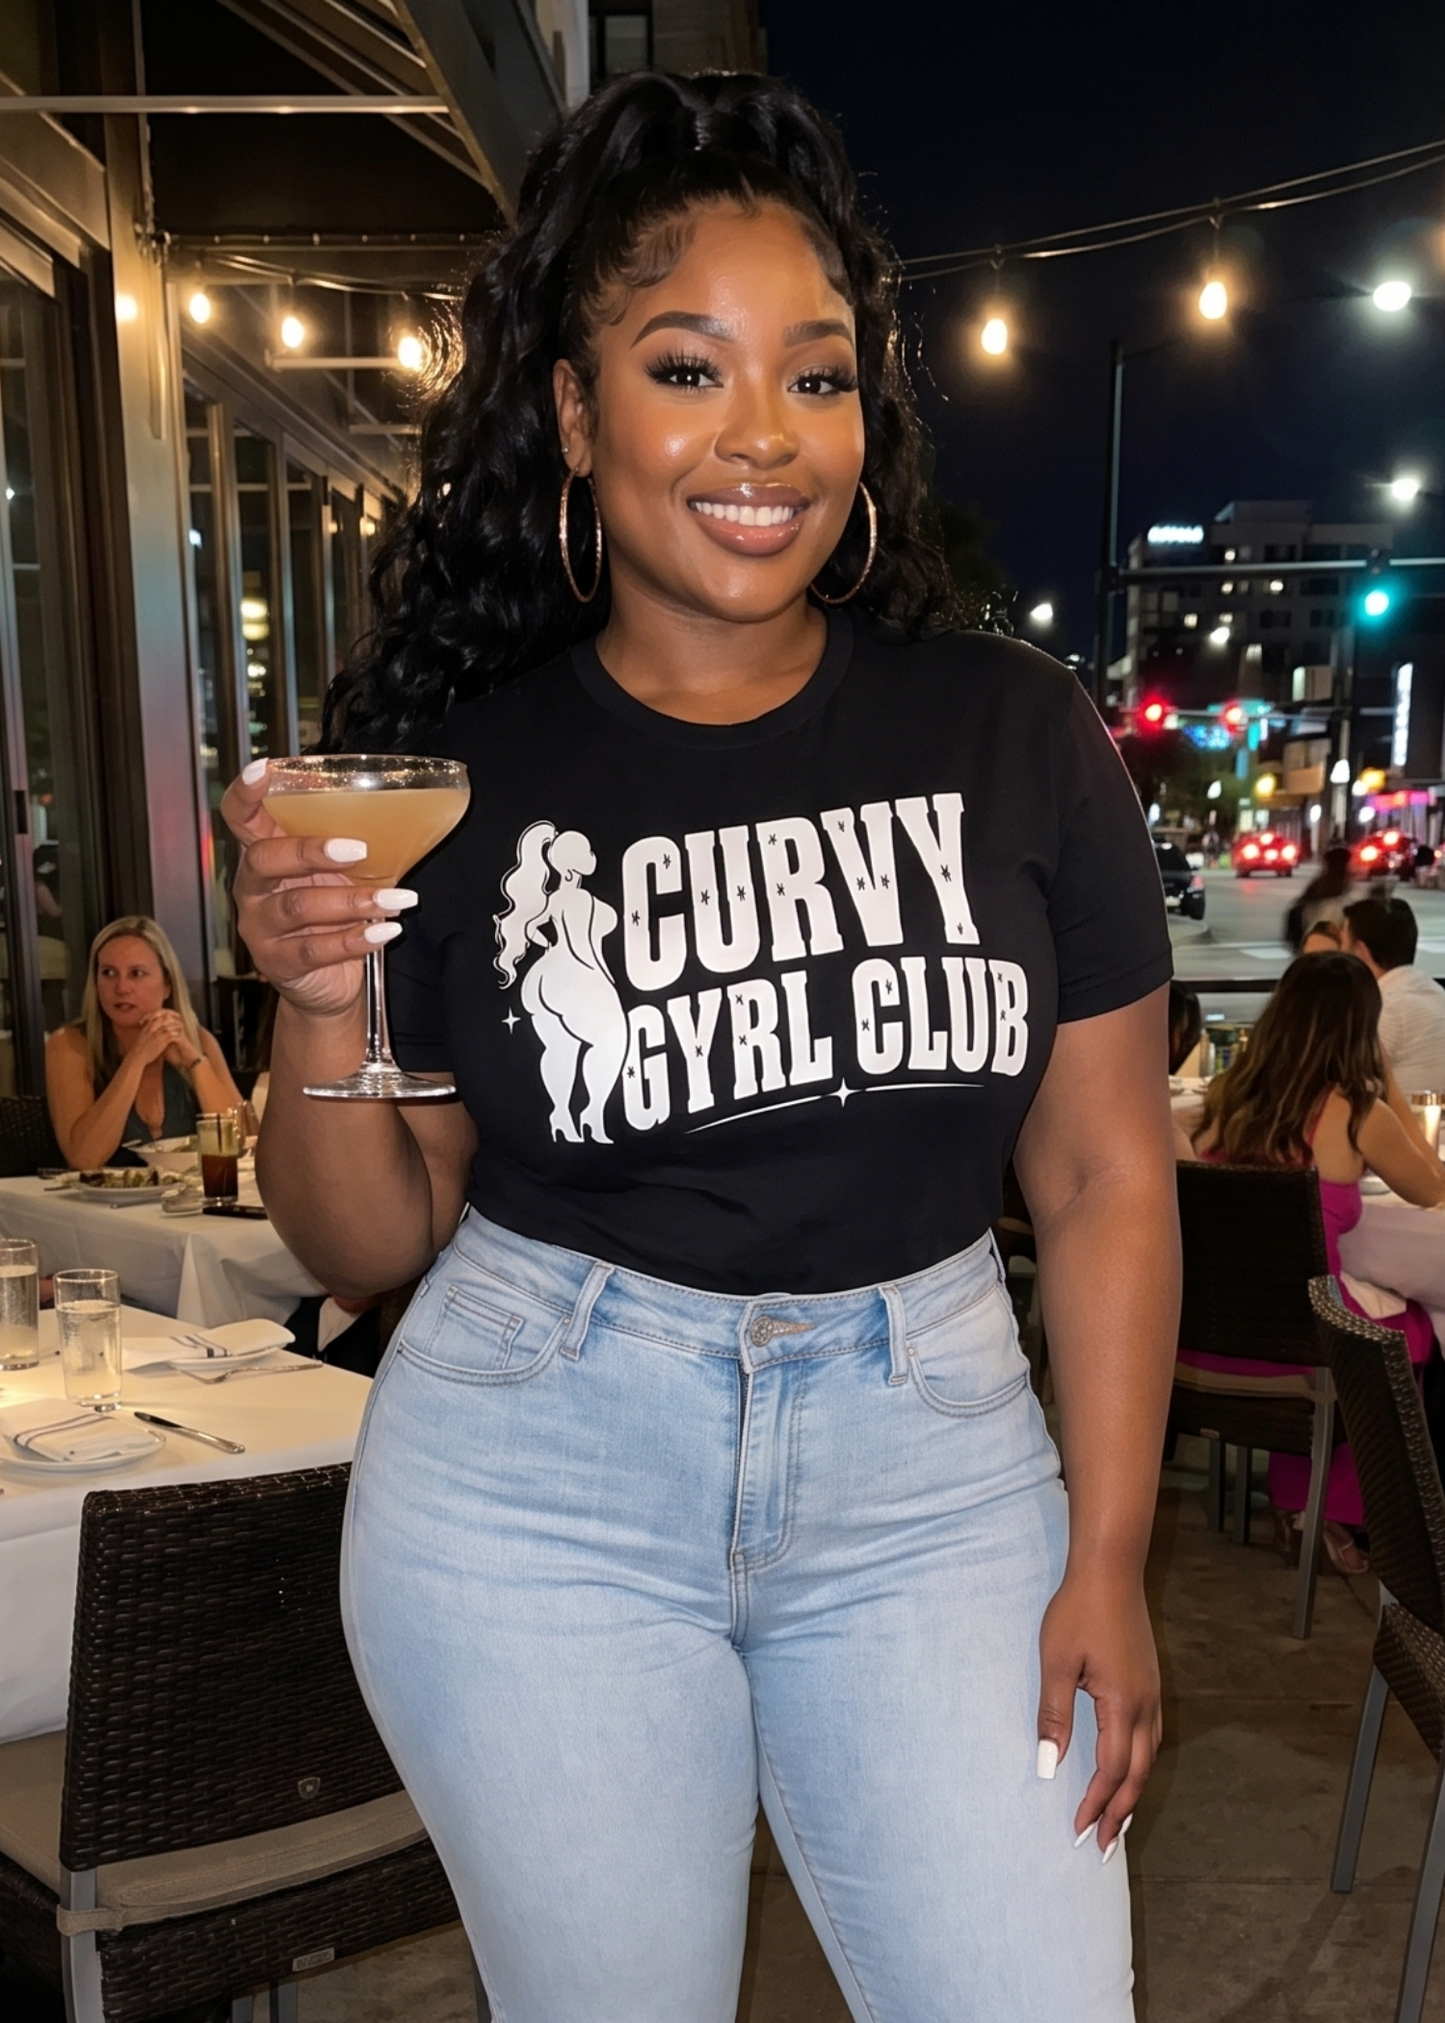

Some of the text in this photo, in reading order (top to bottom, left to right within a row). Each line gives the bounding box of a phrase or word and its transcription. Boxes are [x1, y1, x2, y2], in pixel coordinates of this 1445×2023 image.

[623, 793, 980, 991] CURVY
[621, 957, 1028, 1131] GYRL CLUB
